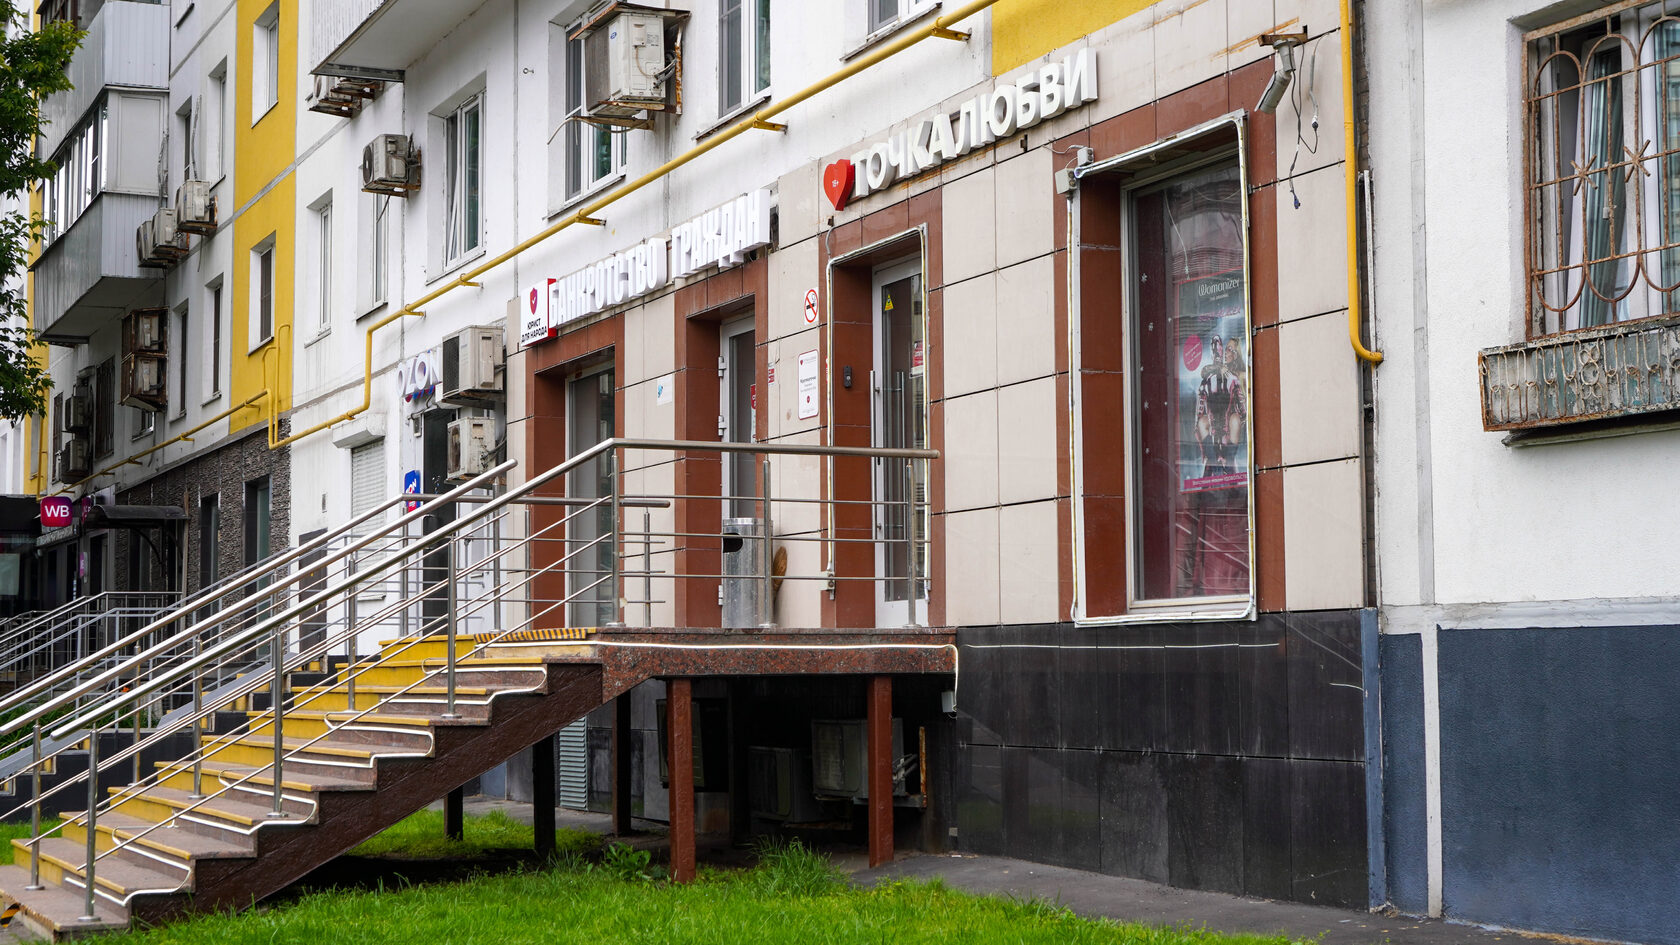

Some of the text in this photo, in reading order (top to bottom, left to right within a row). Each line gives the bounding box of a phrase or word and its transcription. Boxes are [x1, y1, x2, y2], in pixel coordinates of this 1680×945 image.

[549, 189, 769, 328] БАНКРОТСТВО ГРАЖДАН
[1199, 278, 1240, 296] Womanizer
[396, 347, 443, 398] OZON
[44, 505, 70, 518] WB
